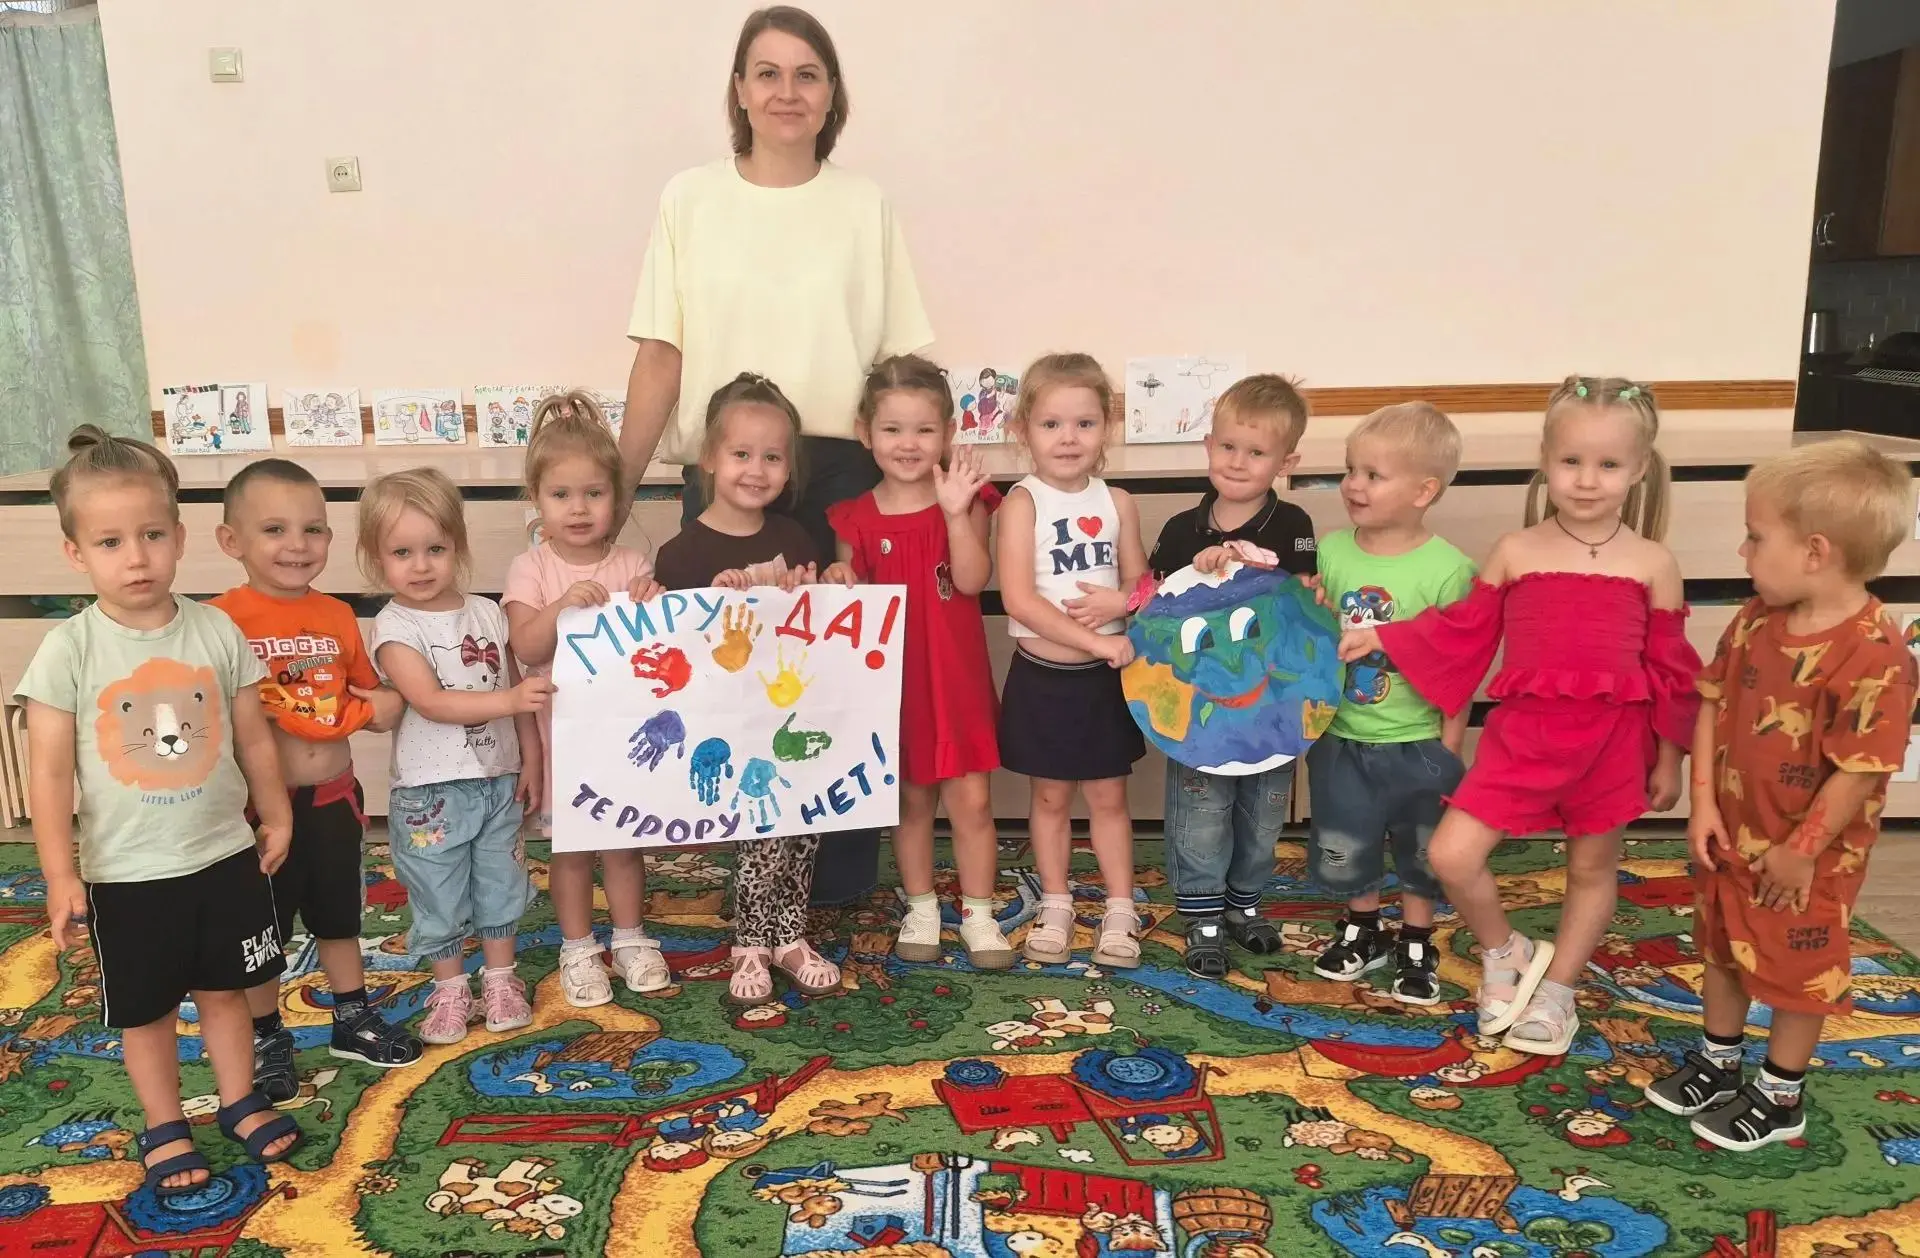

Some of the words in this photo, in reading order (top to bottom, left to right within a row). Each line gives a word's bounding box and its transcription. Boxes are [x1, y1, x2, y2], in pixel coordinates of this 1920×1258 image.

[1051, 517, 1074, 546] I
[1049, 541, 1114, 576] ME
[248, 636, 340, 661] DIGGER
[566, 593, 725, 676] МИРУ
[774, 590, 901, 670] ДА!
[140, 793, 176, 805] LITTLE
[180, 785, 203, 802] LION
[571, 783, 741, 844] ТЕРРОРУ
[800, 731, 896, 825] НЕТ!
[241, 924, 274, 957] PLAY
[244, 939, 281, 973] 2WIN
